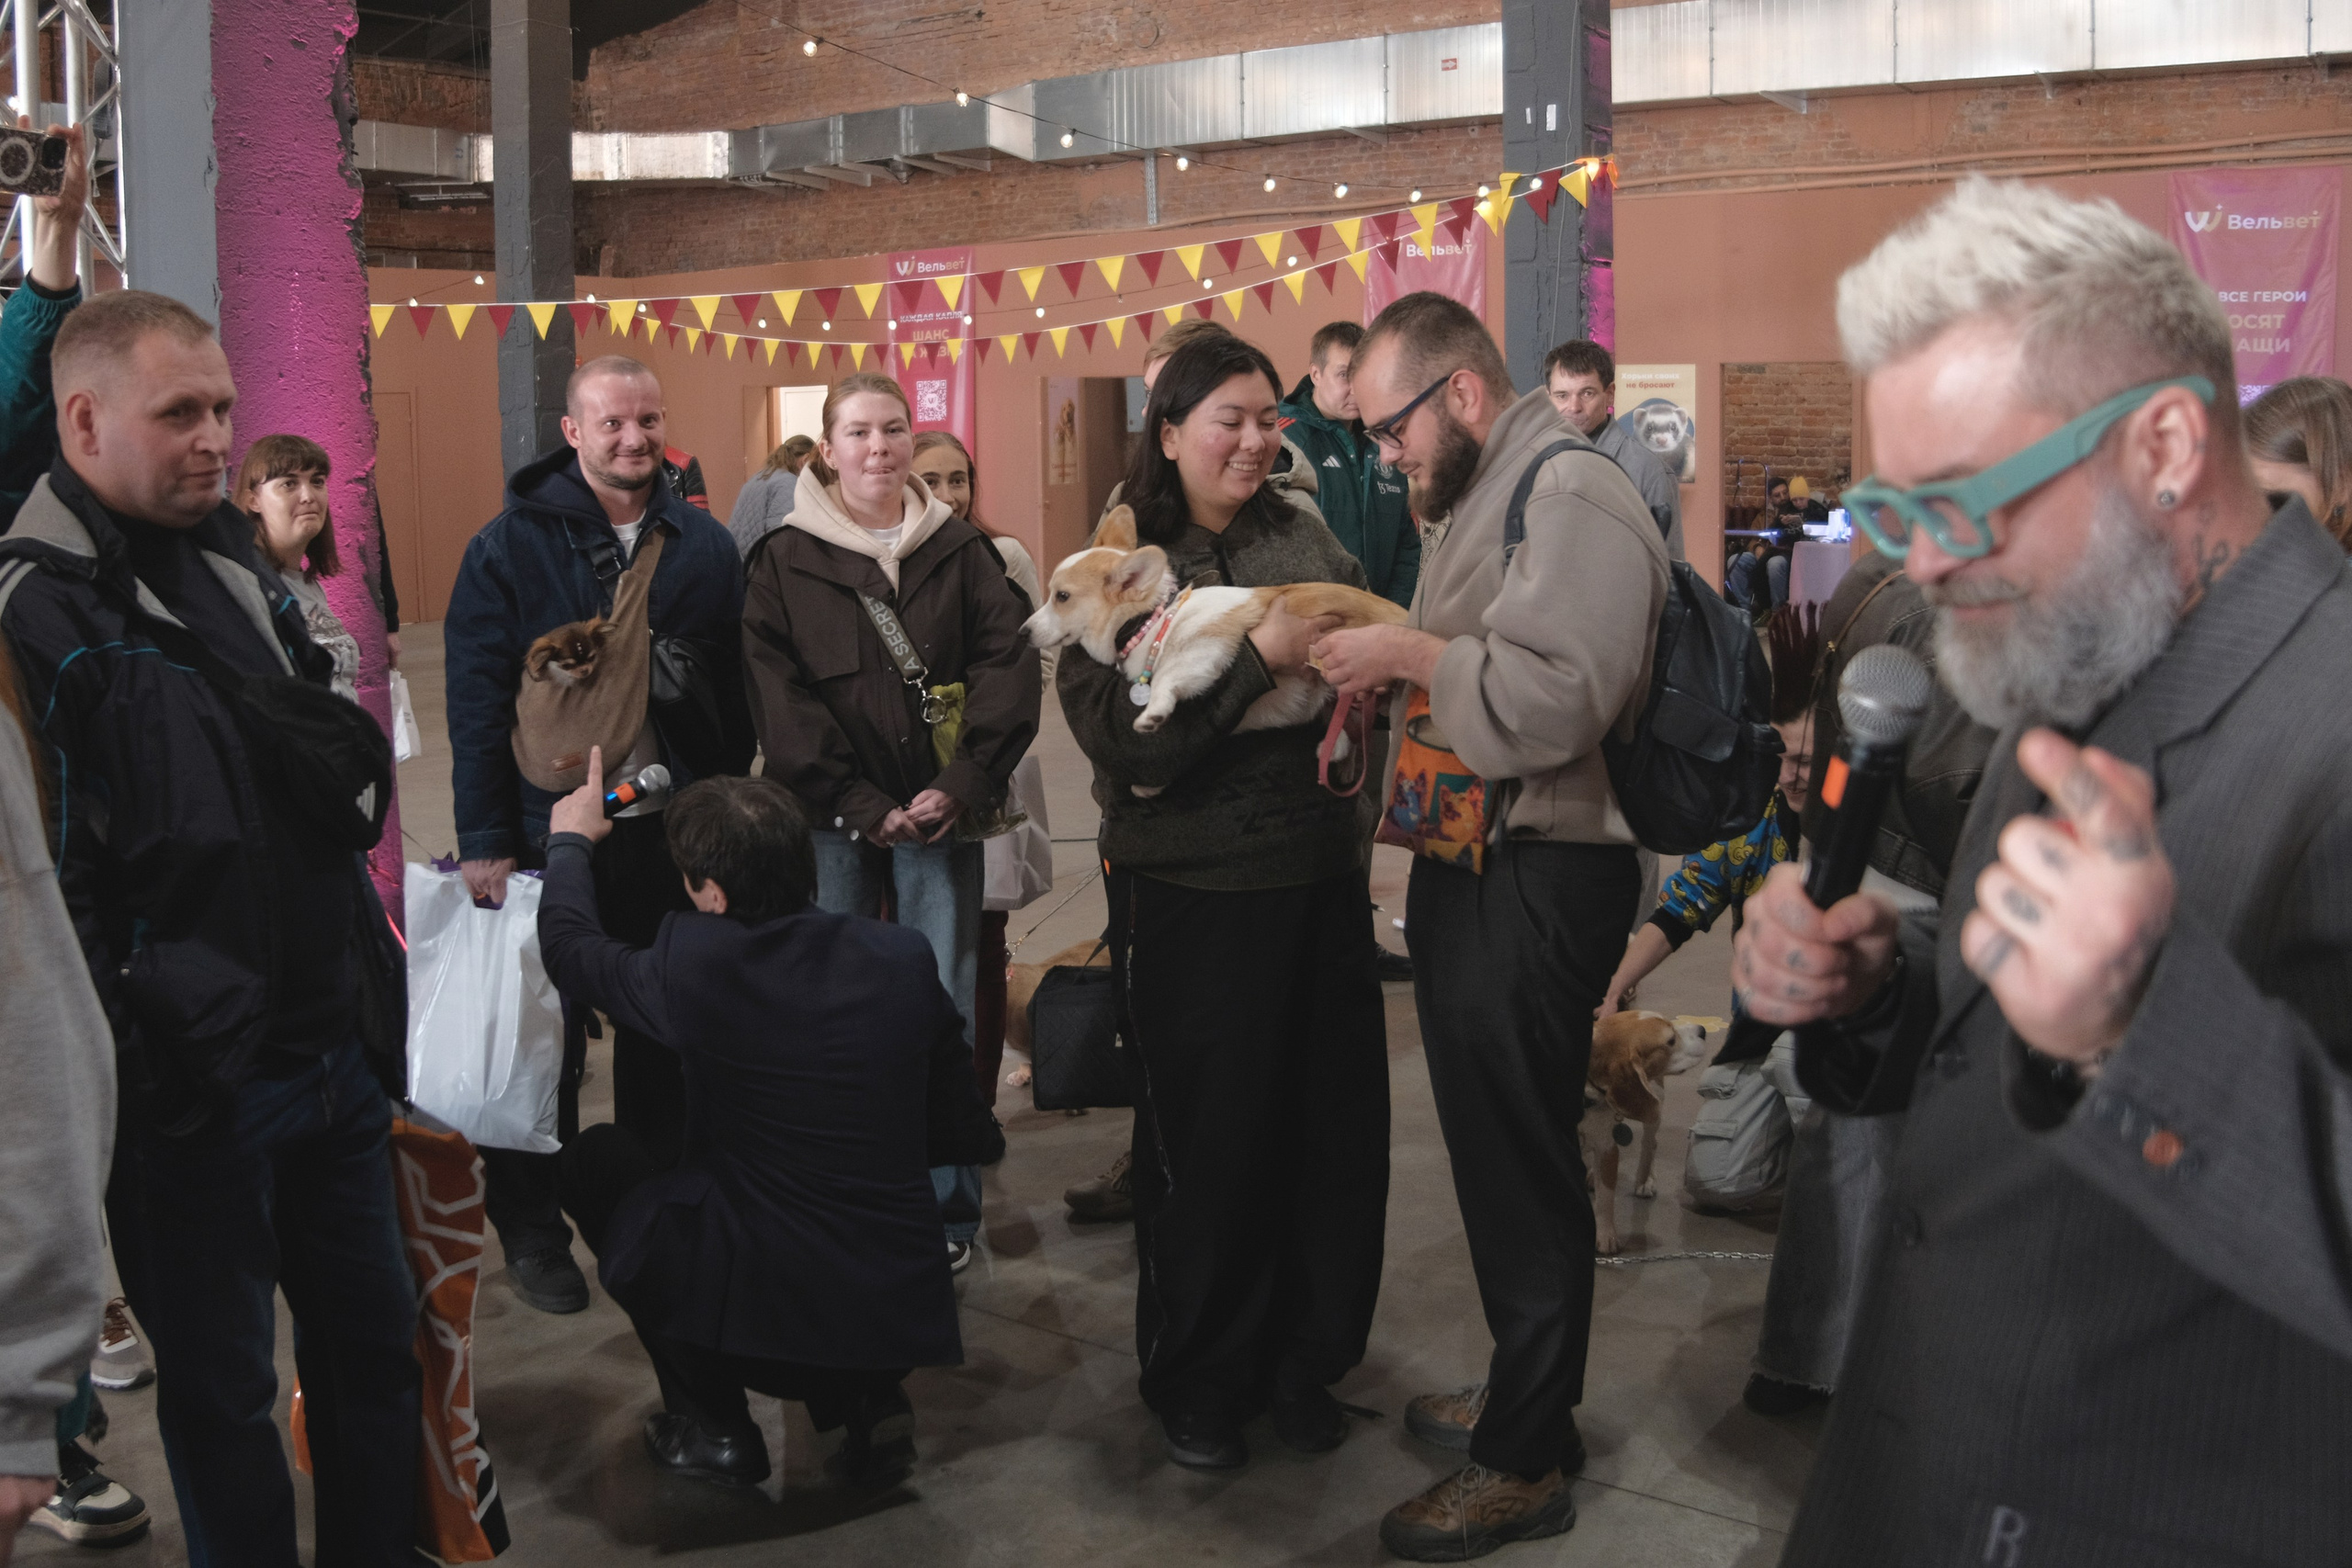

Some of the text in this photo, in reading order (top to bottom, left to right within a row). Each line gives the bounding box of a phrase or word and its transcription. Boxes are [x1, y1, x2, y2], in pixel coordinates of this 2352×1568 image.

[2227, 210, 2321, 230] Вельвет
[917, 258, 966, 273] Вельвет
[2218, 291, 2307, 302] ВСЕ ГЕРОИ
[2227, 313, 2286, 329] ОСЯТ
[912, 329, 950, 341] ШАНС
[2236, 338, 2290, 355] АЩИ
[1638, 381, 1675, 389] бросают
[903, 656, 920, 670] A
